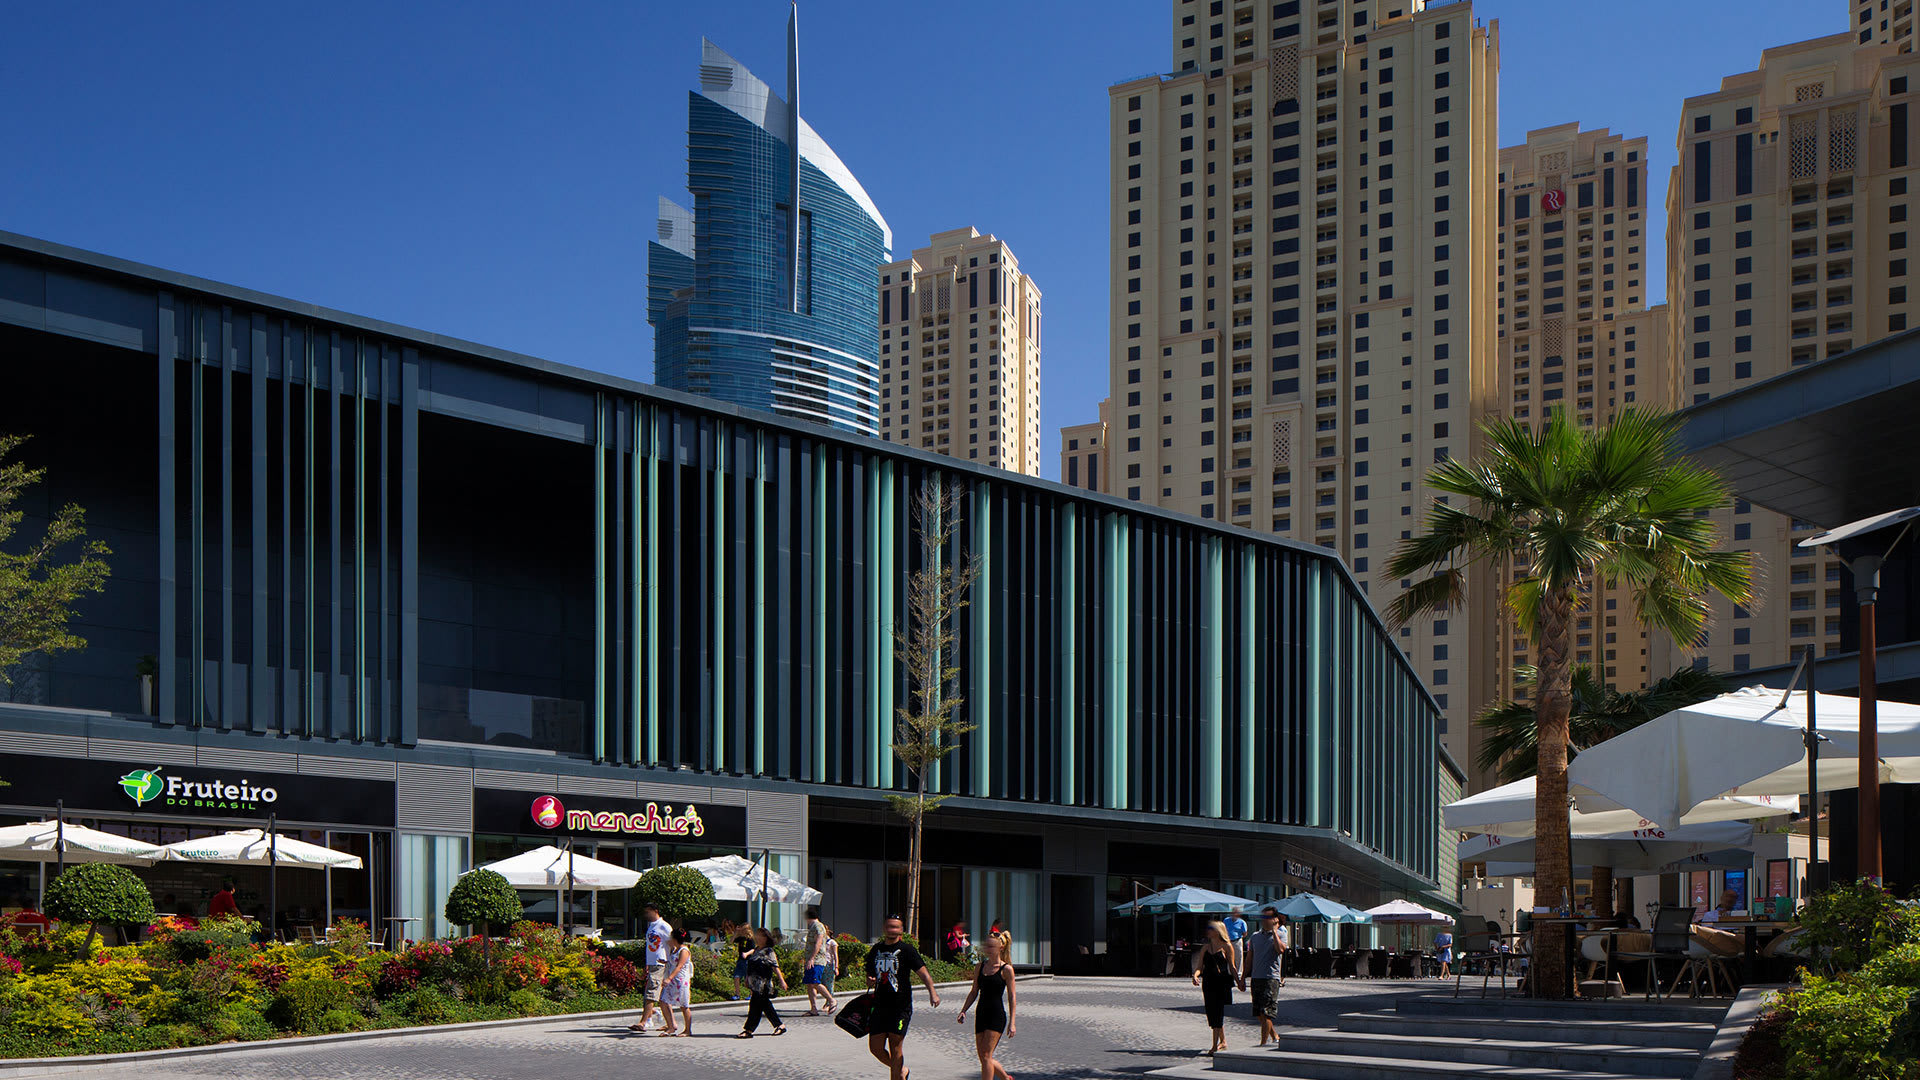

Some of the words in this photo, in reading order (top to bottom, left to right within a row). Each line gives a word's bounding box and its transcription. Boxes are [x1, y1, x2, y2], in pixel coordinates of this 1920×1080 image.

[166, 776, 278, 803] Fruteiro
[166, 798, 189, 806] DO
[194, 799, 256, 810] BRASIL
[567, 802, 704, 837] menchie's
[180, 848, 220, 858] Fruteiro
